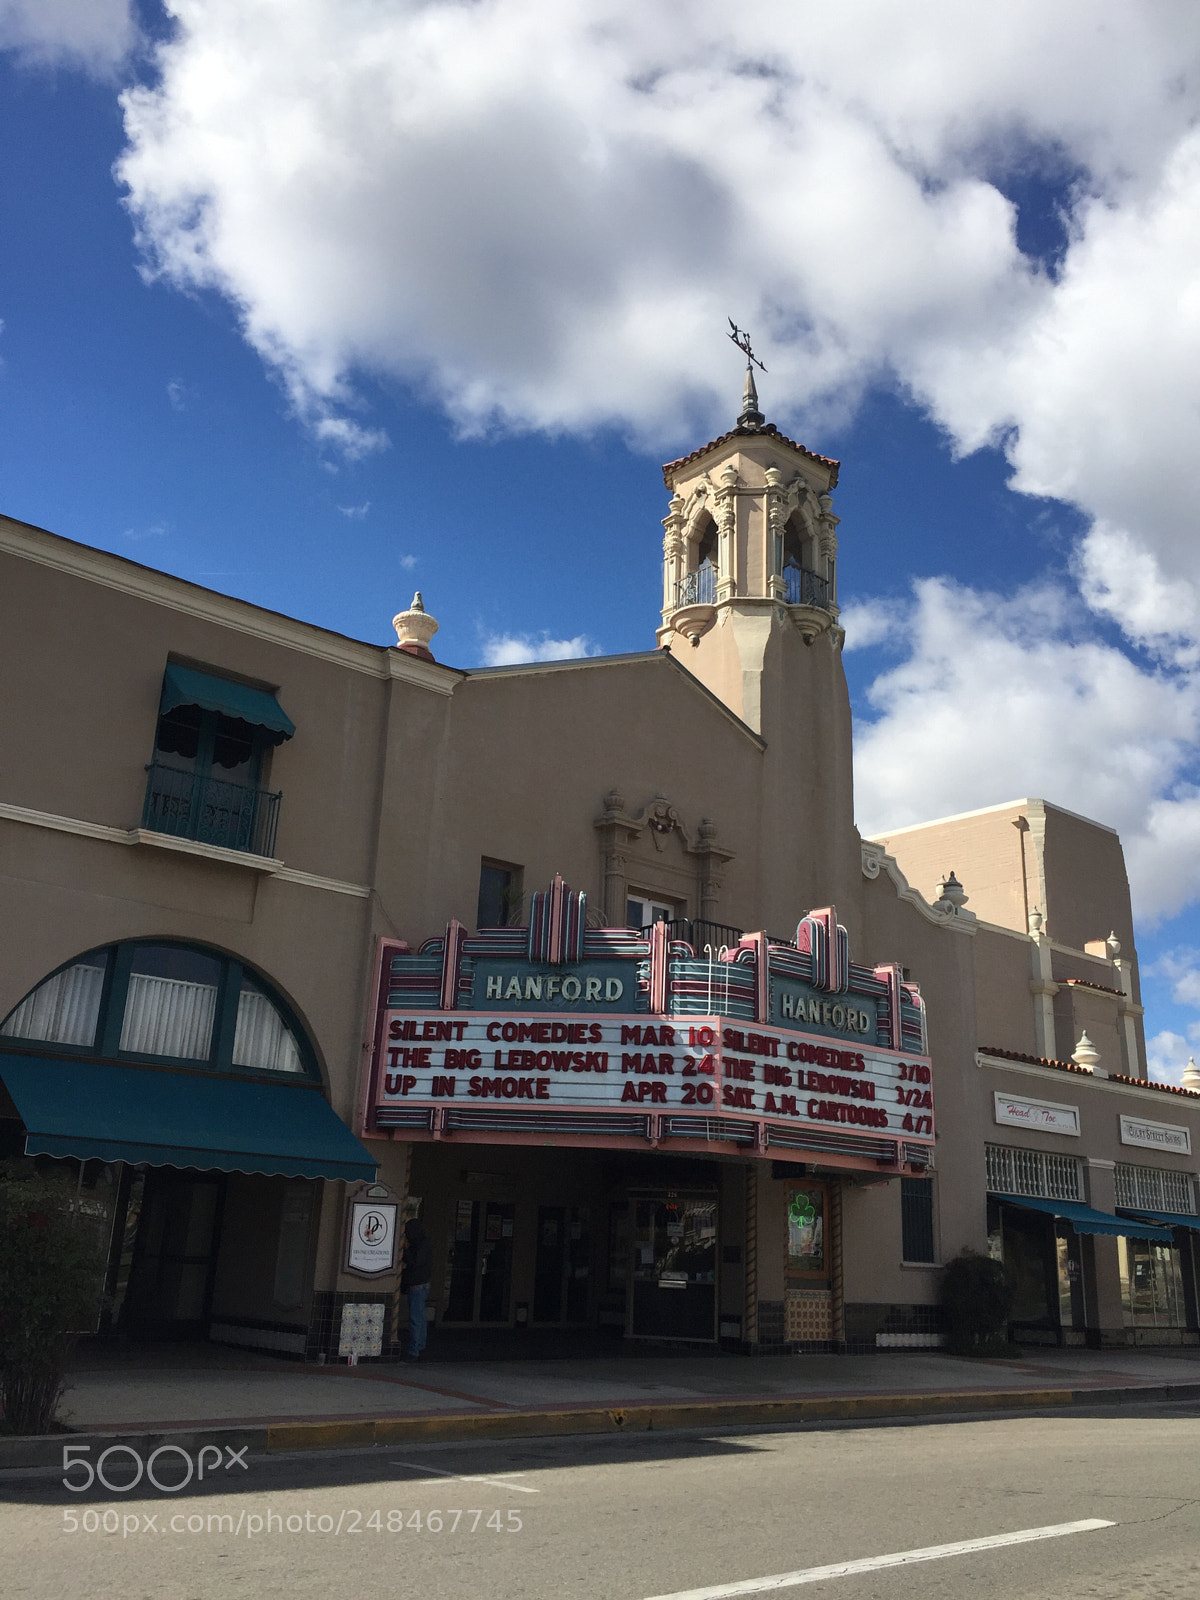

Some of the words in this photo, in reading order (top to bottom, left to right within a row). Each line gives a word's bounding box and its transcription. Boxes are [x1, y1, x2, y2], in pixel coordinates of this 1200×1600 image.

[486, 975, 623, 1002] HANFORD
[782, 994, 870, 1033] HANFORD
[389, 1020, 468, 1042] SILENT
[486, 1021, 602, 1044] COMEDIES
[620, 1025, 675, 1047] MAR
[688, 1026, 714, 1048] 10
[388, 1047, 432, 1068] THE
[443, 1048, 482, 1070] BIG
[494, 1049, 608, 1073] LEBOWSKI
[621, 1053, 675, 1075] MAR
[681, 1054, 714, 1076] 24
[722, 1028, 780, 1058] SILENT
[786, 1041, 866, 1072] COMEDIES
[898, 1062, 931, 1084] 3/10
[384, 1073, 417, 1096] UP
[431, 1075, 456, 1097] IN
[467, 1076, 550, 1100] SMOKE
[621, 1081, 668, 1103] APR
[680, 1082, 714, 1105] 20
[722, 1056, 755, 1082] THE
[763, 1063, 792, 1087] BIG
[798, 1069, 876, 1101] LEBOWSKI
[895, 1085, 932, 1109] 3/24
[722, 1084, 756, 1110] SAT.
[764, 1091, 800, 1117] A.M.
[807, 1098, 888, 1129] CARTOONS
[902, 1112, 932, 1135] 4/7
[1006, 1103, 1030, 1118] Head
[1042, 1110, 1056, 1123] Toe
